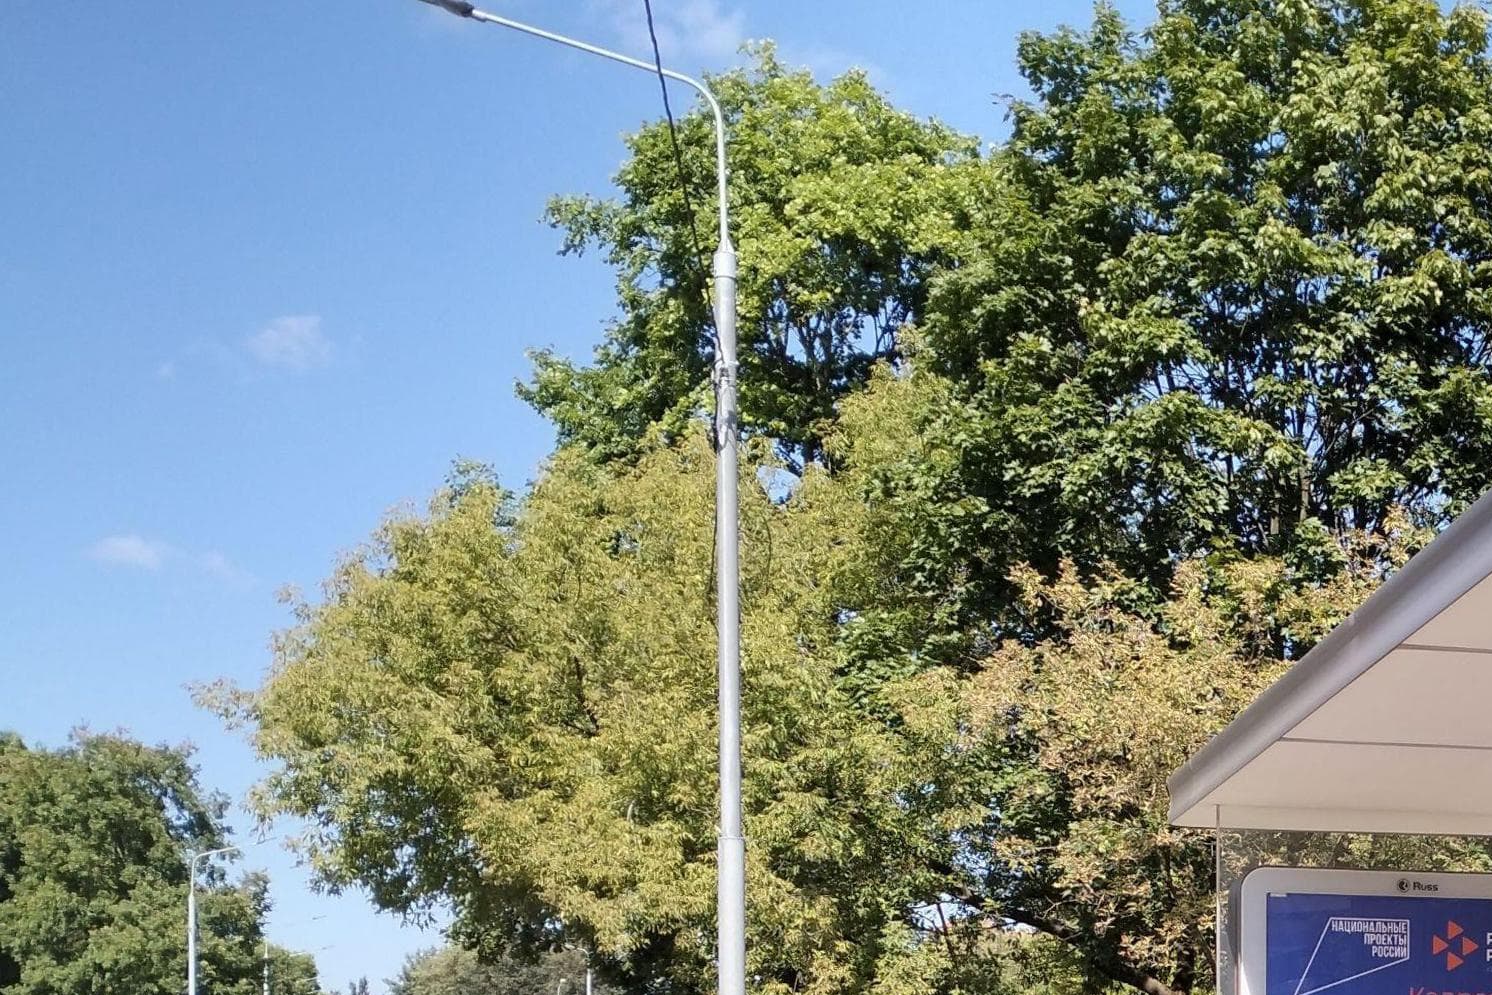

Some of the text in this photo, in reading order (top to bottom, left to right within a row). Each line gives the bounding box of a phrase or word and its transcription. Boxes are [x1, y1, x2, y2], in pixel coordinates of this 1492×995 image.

[1331, 920, 1408, 934] НАЦИОНАЛЬНЫЕ
[1363, 933, 1408, 946] ПРОЕКТЫ
[1371, 945, 1408, 958] РОССИИ
